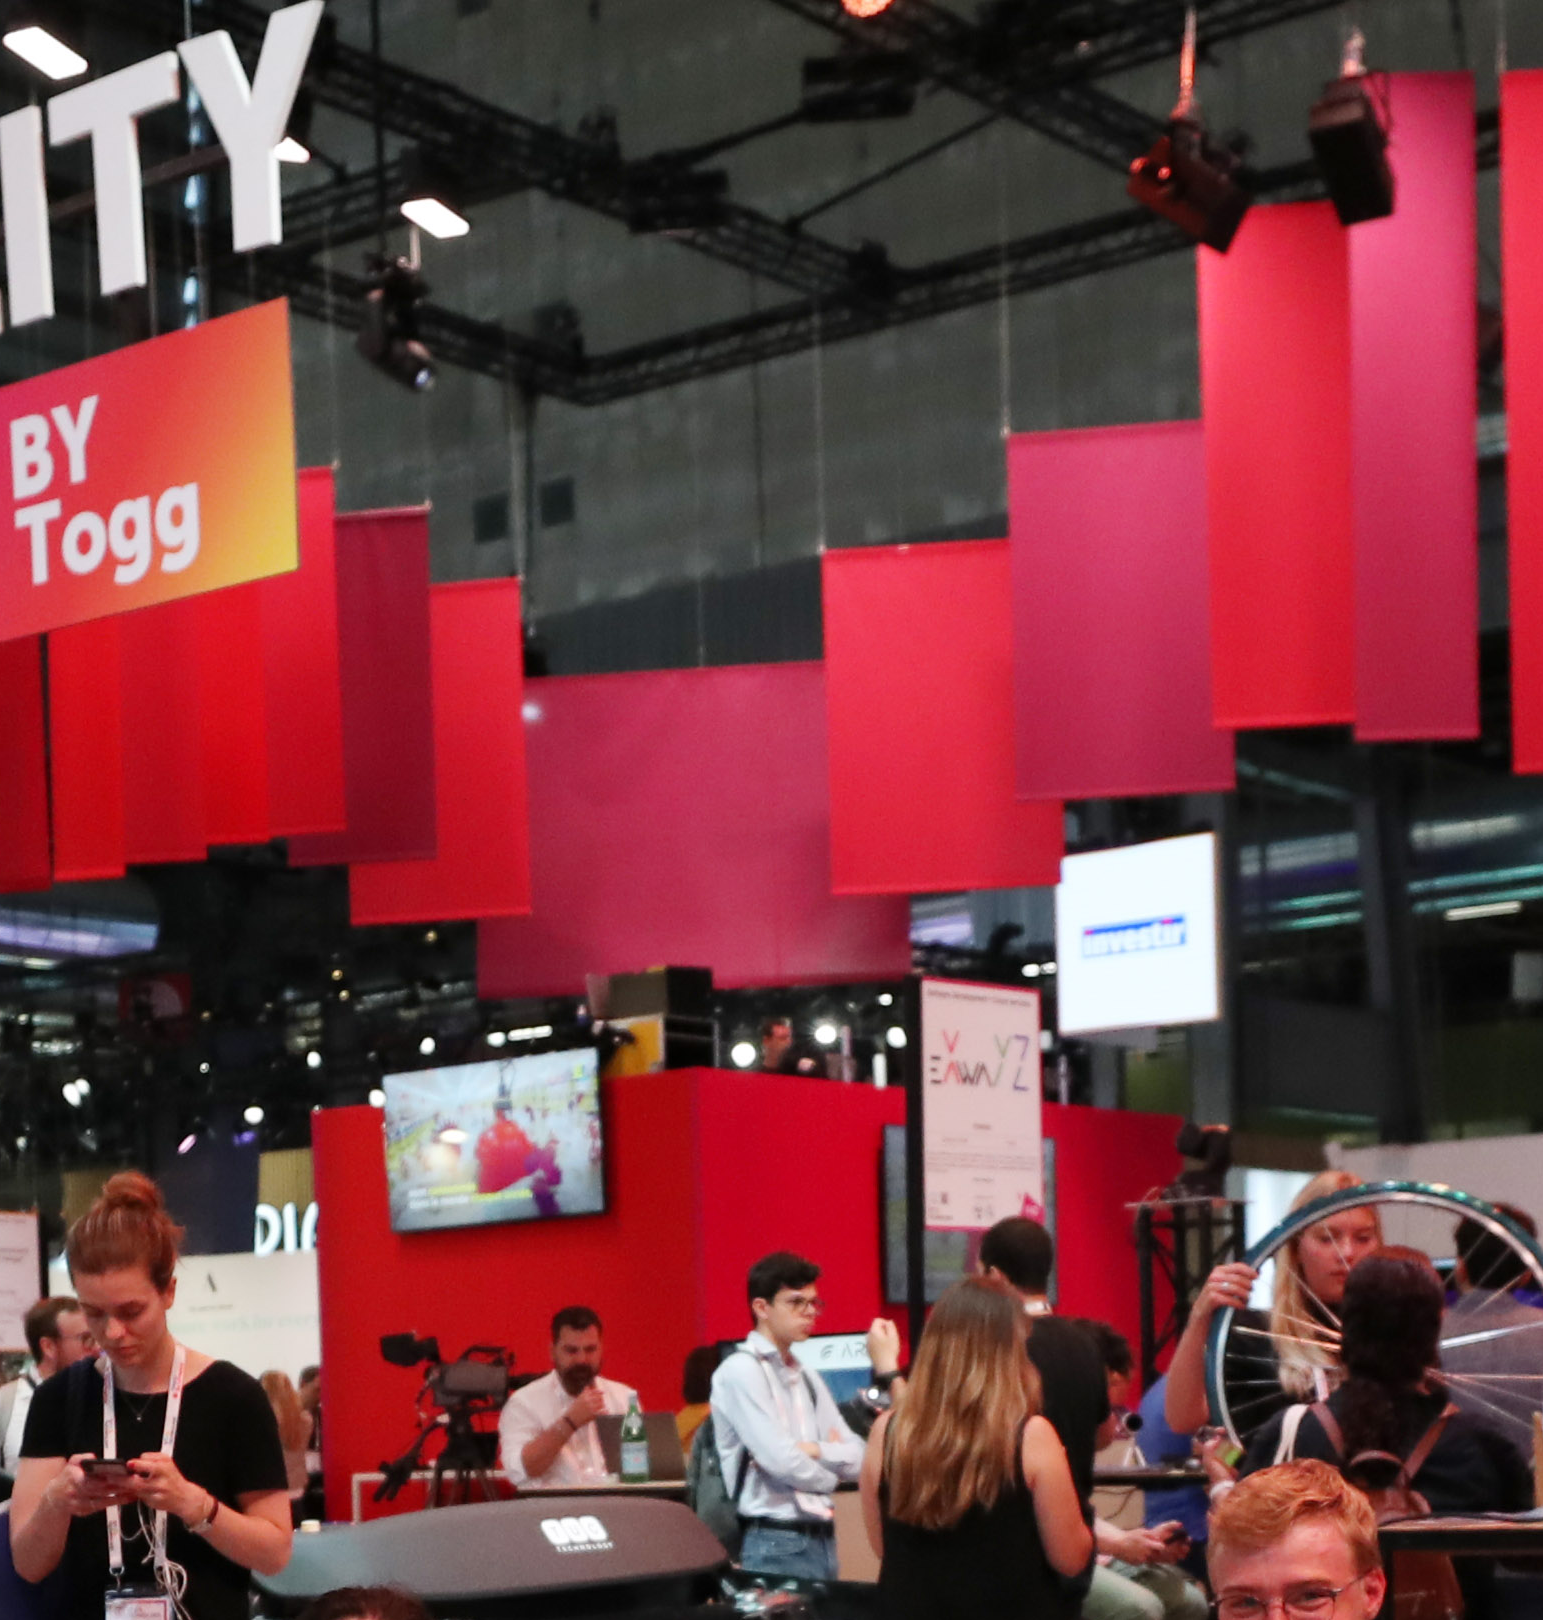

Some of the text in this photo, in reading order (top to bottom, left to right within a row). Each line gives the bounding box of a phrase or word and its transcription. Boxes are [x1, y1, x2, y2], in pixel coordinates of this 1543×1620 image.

[9, 395, 99, 500] BY
[14, 482, 202, 586] Togg
[556, 1541, 614, 1553] TECHNOLOGY
